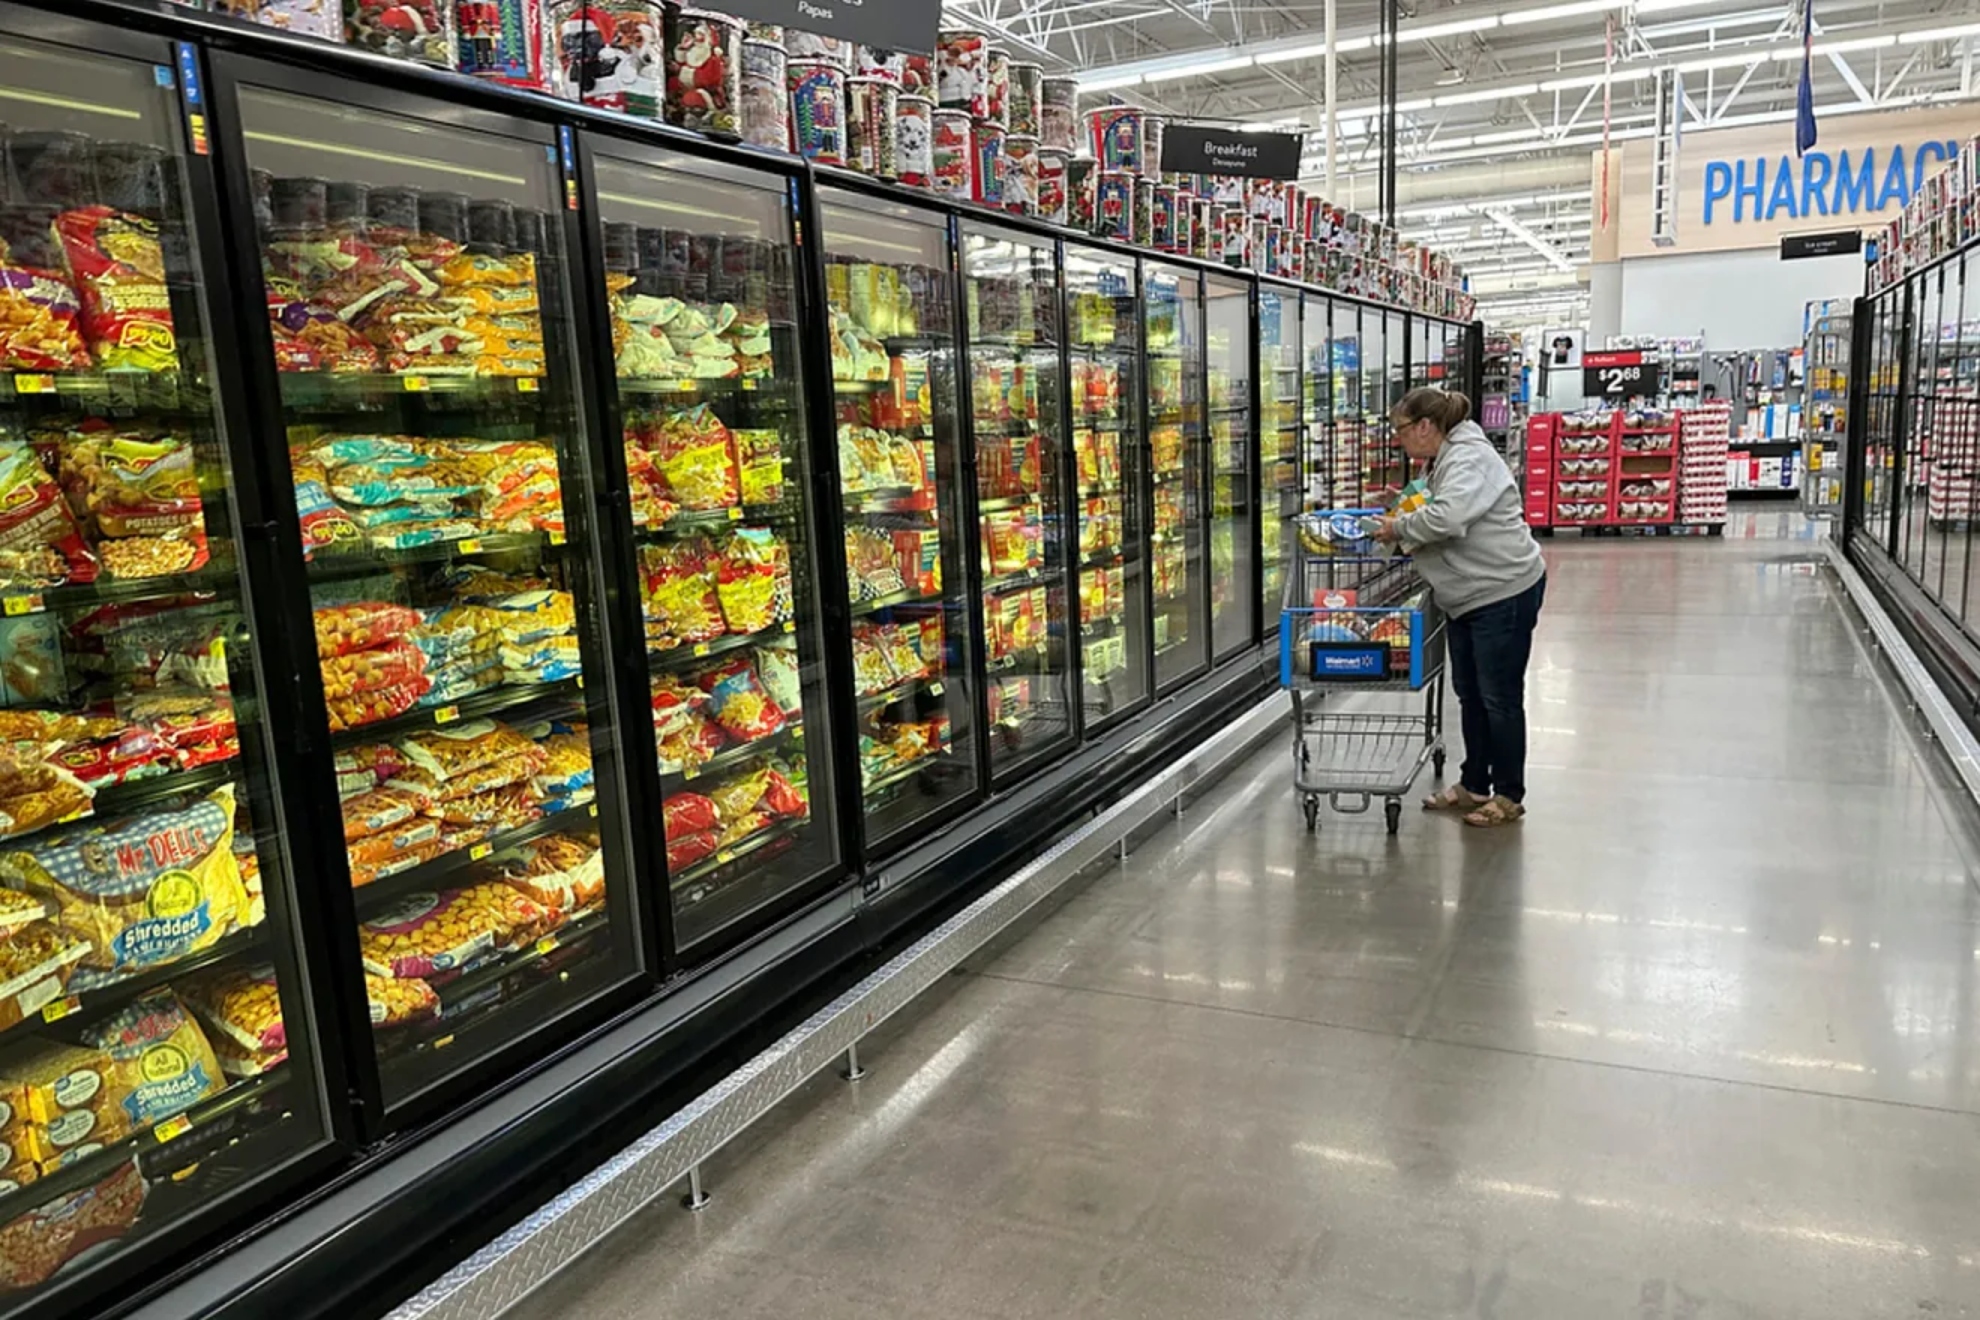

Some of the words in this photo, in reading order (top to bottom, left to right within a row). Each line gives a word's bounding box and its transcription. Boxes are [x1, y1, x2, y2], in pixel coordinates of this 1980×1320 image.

[798, 0, 834, 19] Papas
[1204, 141, 1257, 157] Breakfast
[1703, 140, 1960, 225] PHARMAC
[125, 514, 179, 529] POTATOES
[1325, 655, 1361, 665] Walmart
[124, 911, 200, 949] Shredded
[136, 1072, 197, 1105] Shredded
